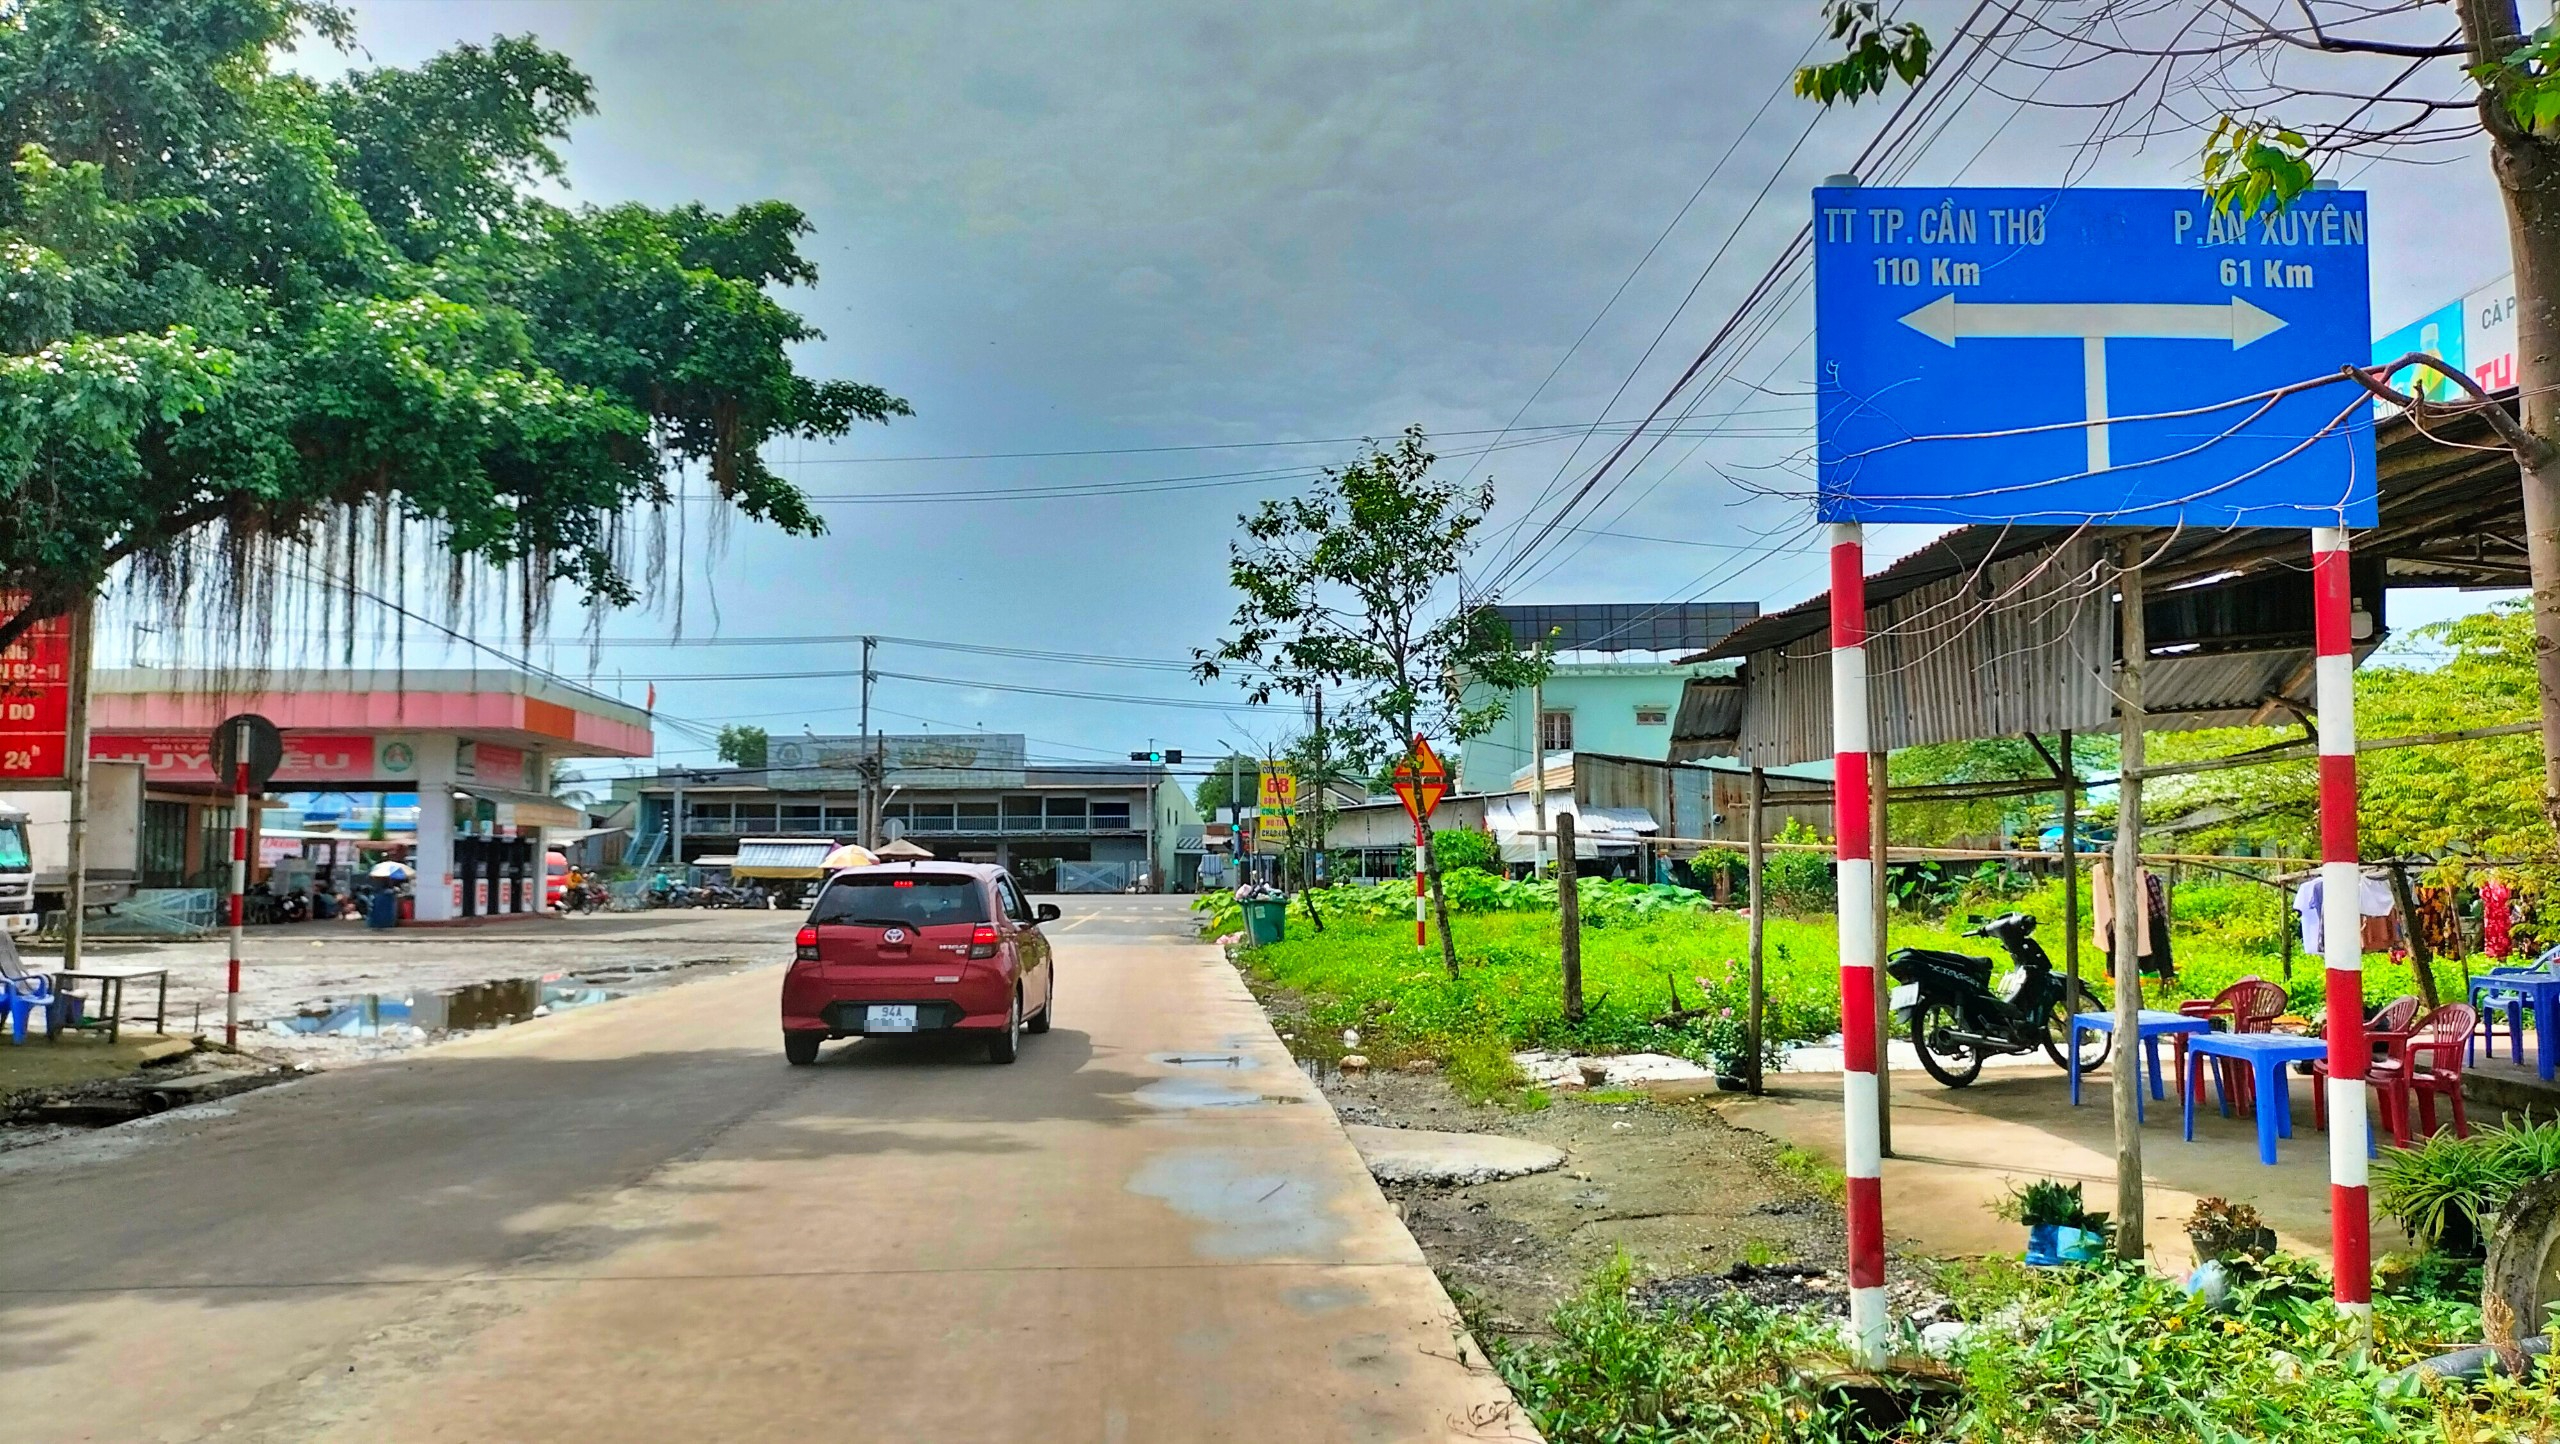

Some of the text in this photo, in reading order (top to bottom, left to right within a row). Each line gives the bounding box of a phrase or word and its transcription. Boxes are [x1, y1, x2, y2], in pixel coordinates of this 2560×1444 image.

[1823, 208, 1857, 243] TT
[1989, 204, 2046, 246] THƠ
[2259, 203, 2364, 247] XUYÊN
[1873, 257, 1980, 287] 110 Km
[2219, 258, 2314, 289] 61 Km
[2481, 299, 2503, 330] CÀ
[1267, 777, 1289, 793] 68
[882, 1006, 902, 1017] 94A
